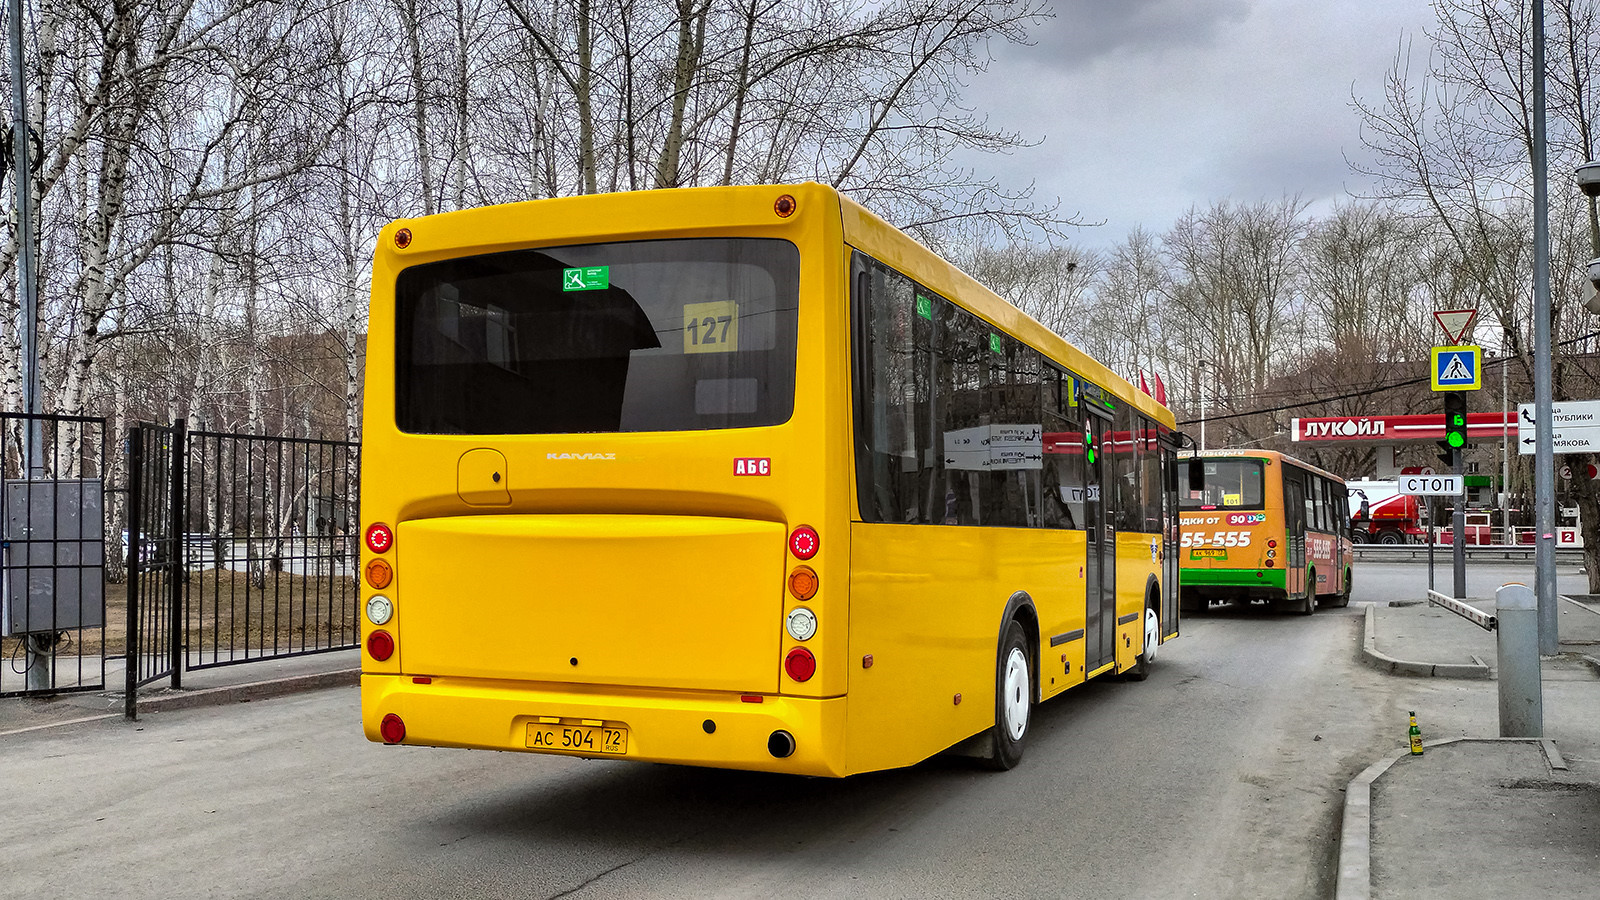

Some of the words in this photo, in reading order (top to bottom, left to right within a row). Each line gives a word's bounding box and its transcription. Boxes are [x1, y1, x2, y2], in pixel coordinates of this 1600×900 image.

[687, 315, 732, 345] 127
[1553, 414, 1593, 422] ПУБЛИКИ
[1304, 418, 1385, 437] ЛУКОЙЛ
[736, 459, 768, 475] АБС
[1407, 478, 1454, 492] СТОП
[1206, 517, 1220, 525] от
[1230, 515, 1246, 524] 90
[1180, 531, 1252, 548] 55-555
[1564, 532, 1572, 541] 2
[534, 731, 554, 746] АС
[562, 728, 593, 749] 504
[604, 730, 621, 745] 72
